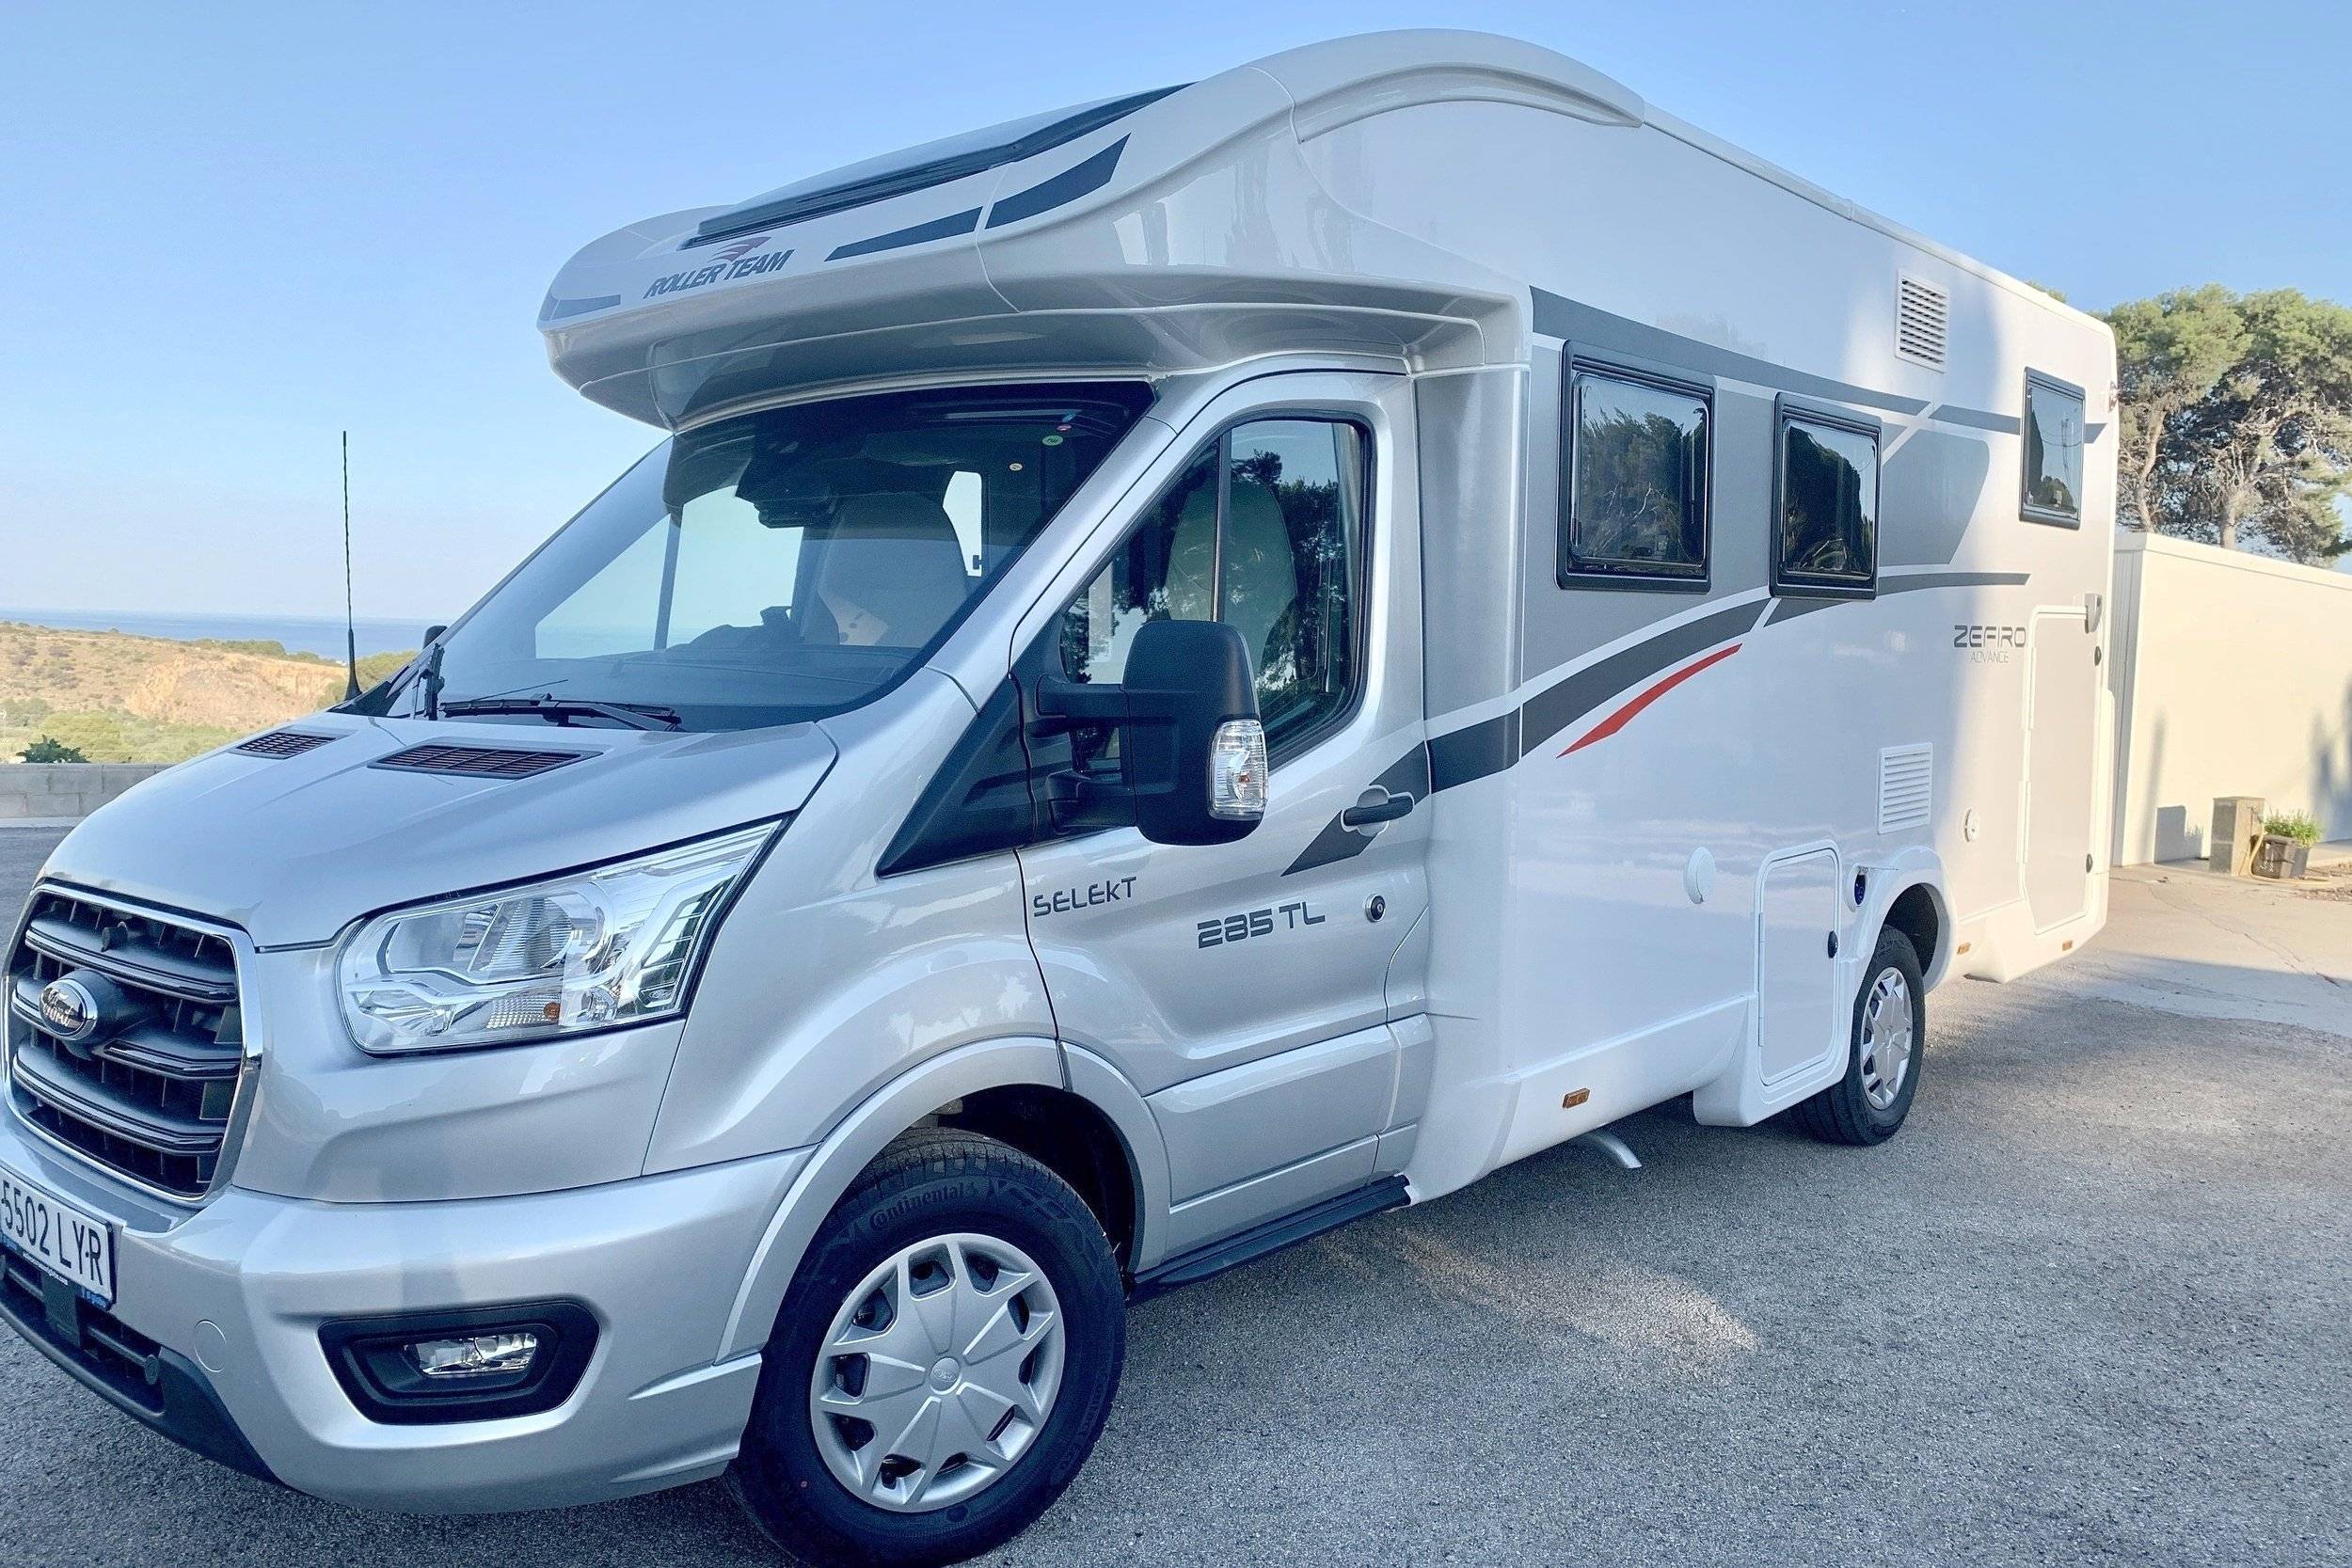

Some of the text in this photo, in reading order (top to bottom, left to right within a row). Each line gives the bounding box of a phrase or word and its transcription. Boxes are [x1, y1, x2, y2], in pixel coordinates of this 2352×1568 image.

[643, 248, 796, 300] ROLLER TEAM
[1953, 625, 2026, 648] ZEFIRO
[1969, 650, 2010, 664] ADVANCE
[1033, 876, 1137, 918] SELEKT
[1197, 901, 1326, 949] 285 TL
[869, 1180, 964, 1230] Continental
[1, 1180, 51, 1257] 5502
[56, 1212, 103, 1286] LYR
